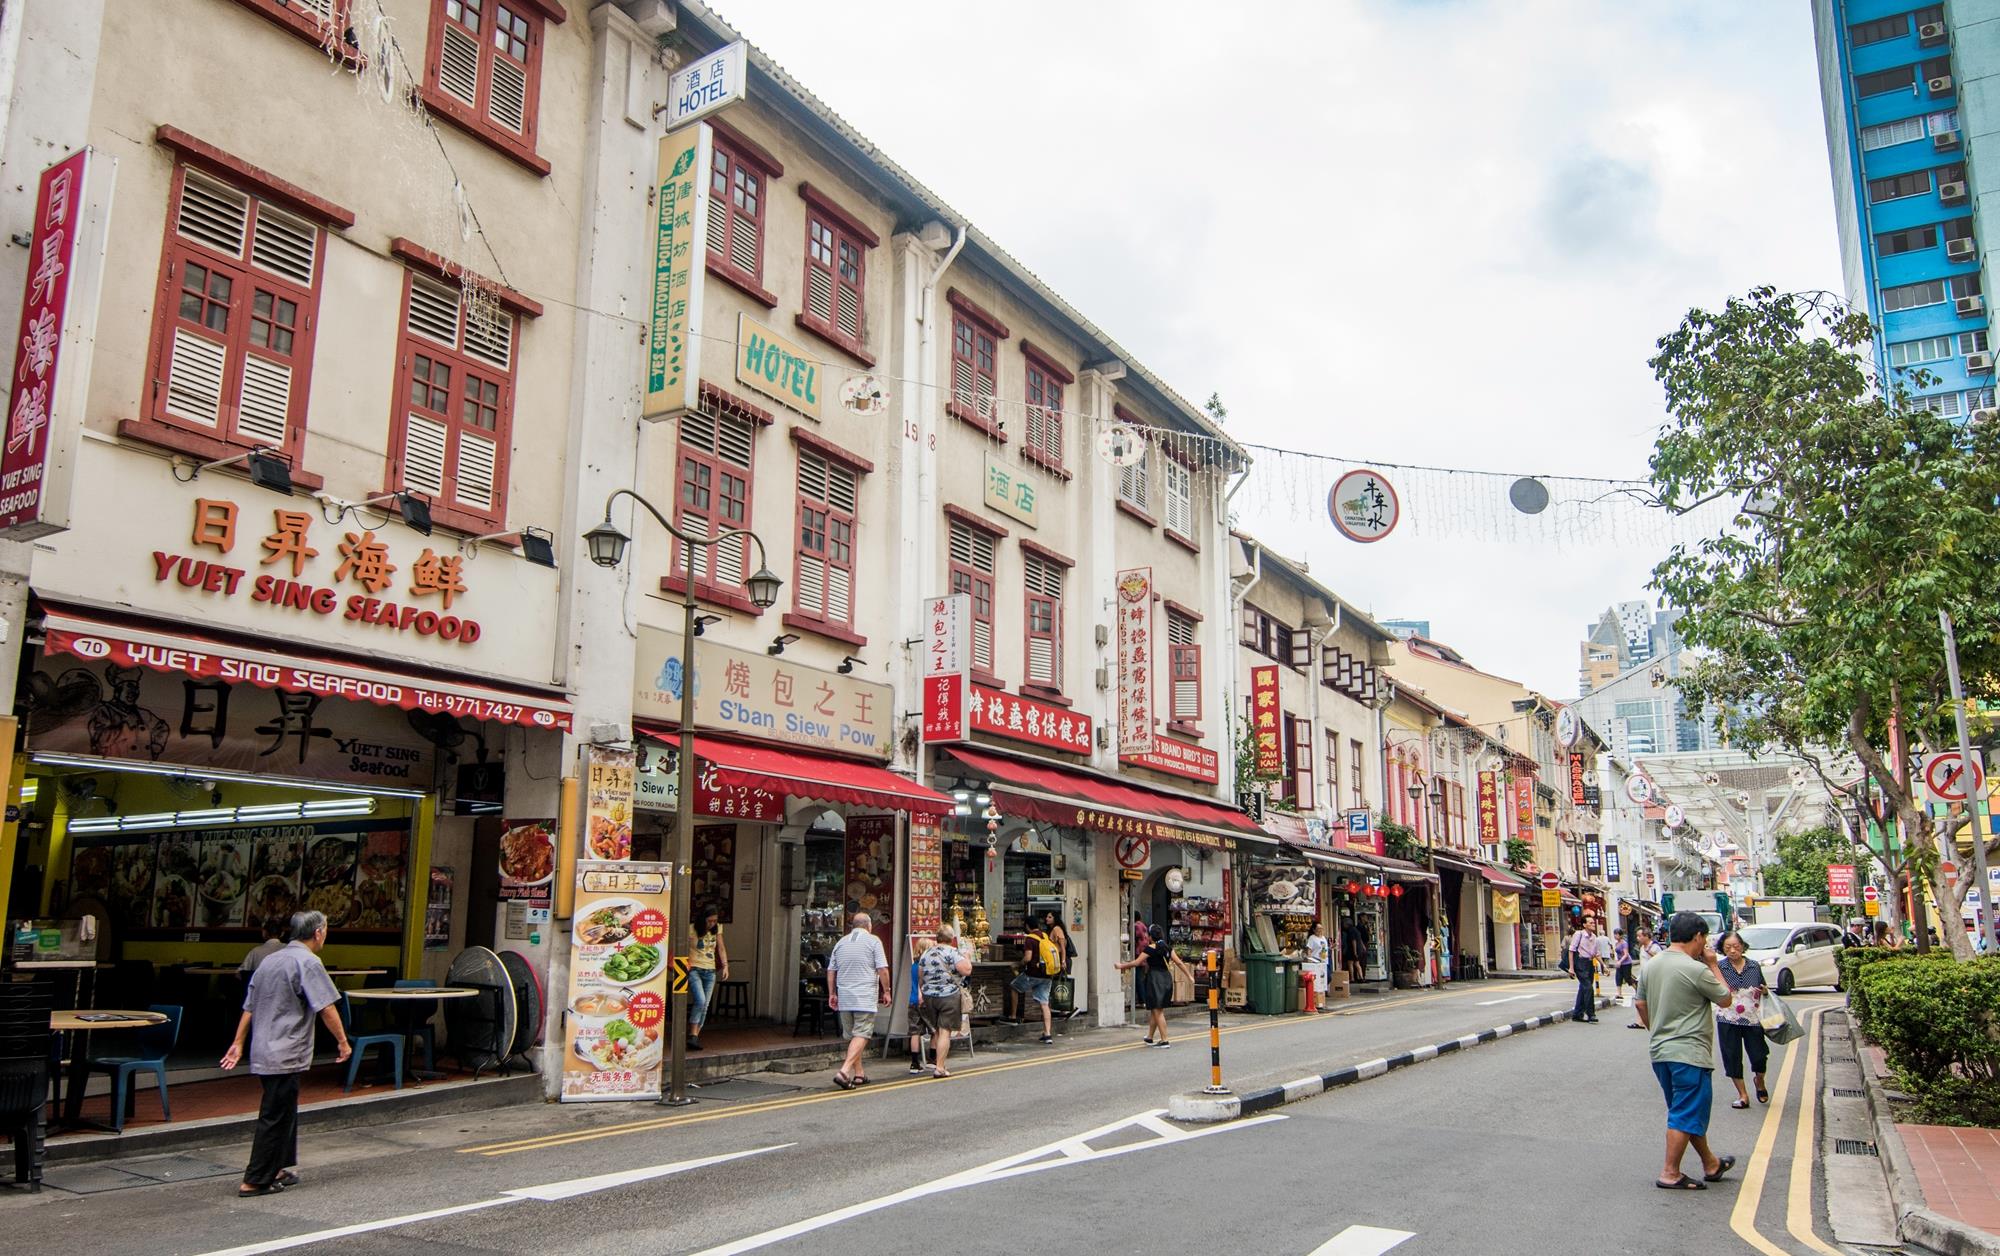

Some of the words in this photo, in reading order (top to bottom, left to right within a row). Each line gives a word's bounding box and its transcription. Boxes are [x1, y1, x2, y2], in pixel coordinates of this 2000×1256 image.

[687, 59, 724, 92] 酒店
[679, 79, 727, 116] HOTEL
[661, 185, 675, 225] HOTEL
[658, 229, 672, 268] POINT
[669, 181, 692, 319] 唐城坊酒店
[653, 272, 670, 350] CHINATOWN
[652, 353, 665, 376] YES
[746, 333, 817, 405] HOTEL
[2, 468, 19, 491] YUET
[22, 463, 43, 485] SING
[991, 466, 1035, 513] 酒店
[0, 489, 38, 515] SEAFOOD
[10, 516, 18, 525] 70
[153, 551, 245, 595] YUET
[252, 575, 337, 614] SING
[344, 595, 481, 644] SEAFOOD
[81, 641, 102, 654] 70
[127, 642, 207, 672] YUET
[221, 658, 280, 684] SING
[292, 670, 402, 702] SEAFOOD
[485, 703, 522, 721] 7427
[724, 658, 874, 725] 燒包之王
[538, 713, 550, 722] 70
[720, 700, 774, 728] S'ban
[786, 712, 829, 738] Siew
[840, 725, 875, 746] Pow
[334, 738, 380, 757] YUET
[385, 746, 420, 762] SING
[1160, 741, 1181, 758] BRAND
[1183, 748, 1201, 763] BIRD'S
[1202, 754, 1215, 767] NEST
[350, 757, 410, 778] Seafood
[593, 768, 622, 788] 日昇
[1570, 755, 1585, 802] MASSAGE
[642, 781, 664, 794] Siew
[668, 784, 679, 797] Po
[258, 825, 314, 843] SEAFOOD
[609, 875, 639, 890] 日昇
